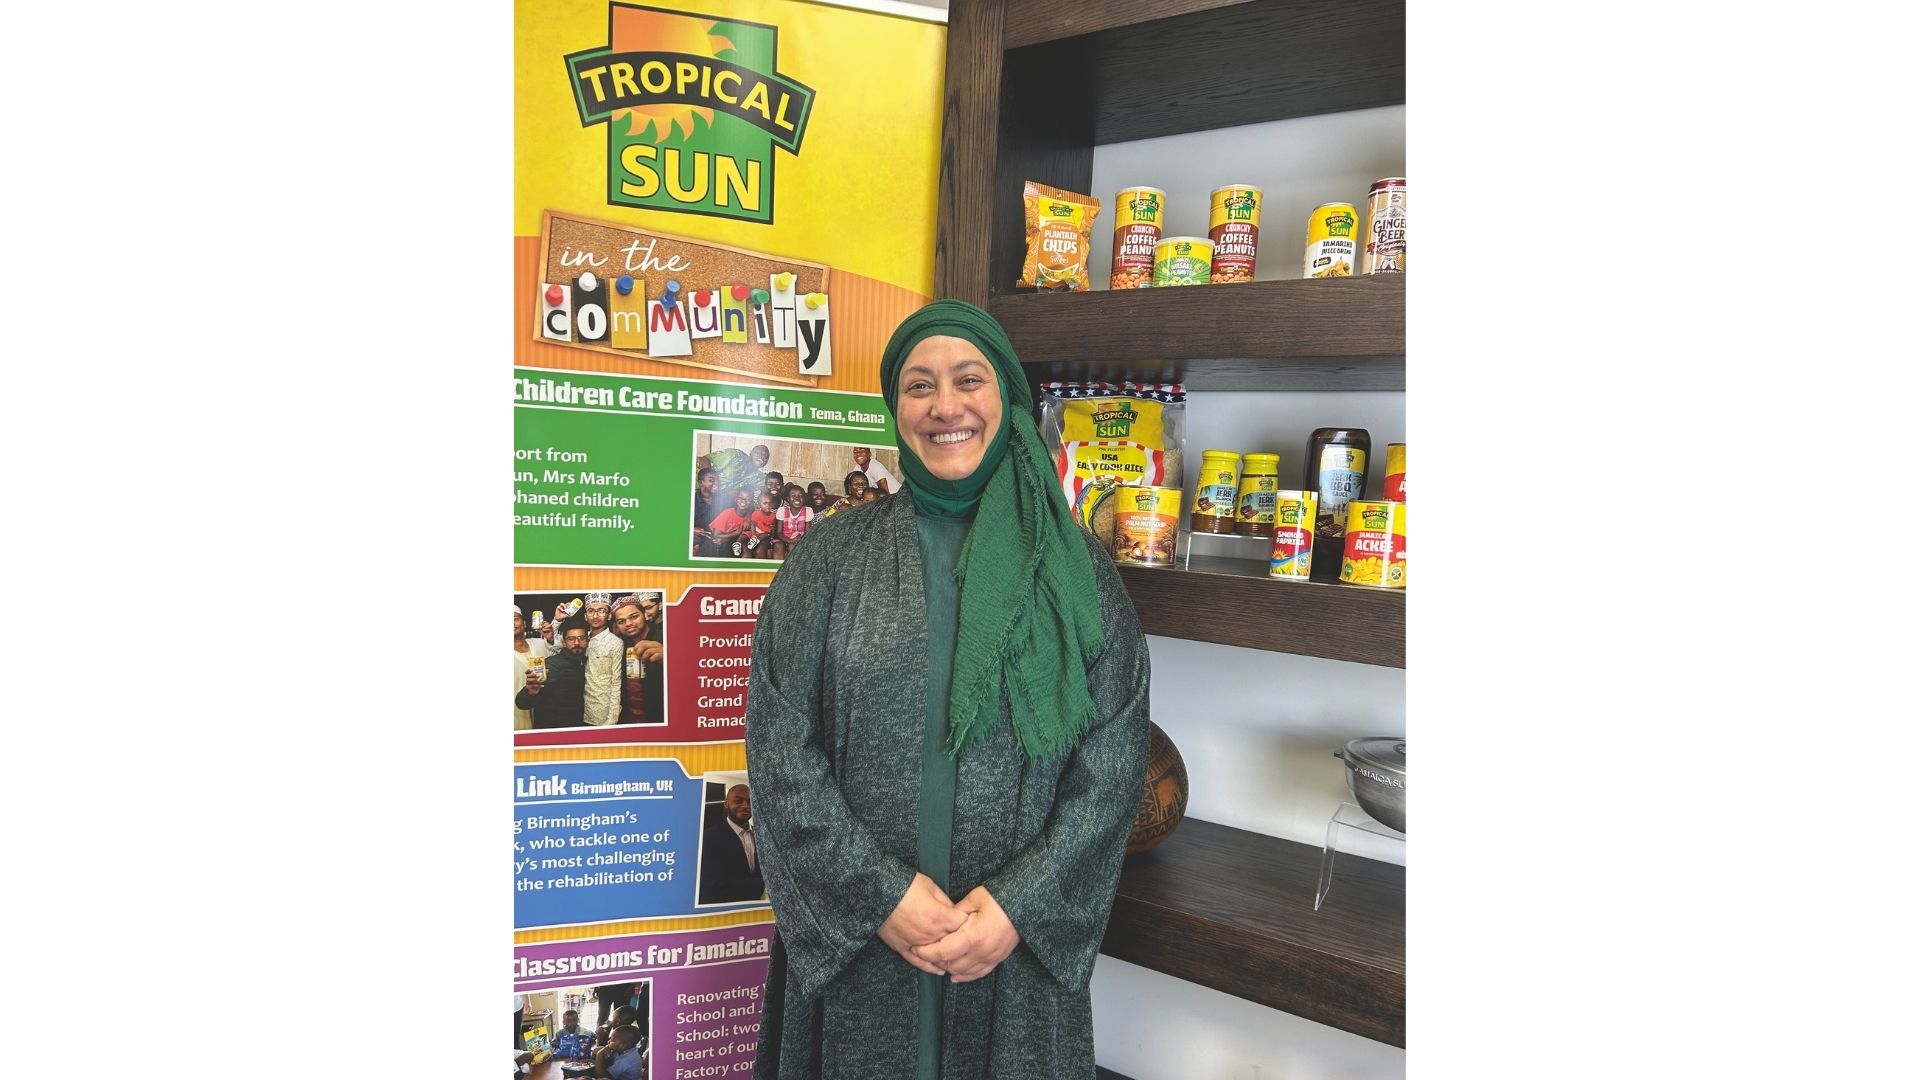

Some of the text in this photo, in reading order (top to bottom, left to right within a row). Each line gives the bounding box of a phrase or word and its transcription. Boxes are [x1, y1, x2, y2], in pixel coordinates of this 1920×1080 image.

[580, 60, 795, 131] TROPICAL
[619, 143, 762, 212] SUN
[1131, 200, 1158, 209] TROPICAL
[1226, 197, 1256, 208] TROPICAL
[1135, 211, 1154, 221] SUN
[1230, 209, 1250, 218] SUN
[1327, 216, 1353, 225] TROPICAL
[1044, 230, 1078, 240] PLANTAIN
[1131, 225, 1156, 234] CRUNCHY
[1226, 223, 1252, 233] CRUNCHY
[1330, 227, 1349, 235] SUN
[1221, 233, 1253, 245] COFFEE
[1379, 229, 1405, 243] BEER
[1043, 239, 1078, 254] CHIPS
[1120, 245, 1155, 256] PEANUT
[1214, 244, 1256, 257] PEANUTS
[560, 240, 690, 272] in the
[514, 378, 885, 424] Children Care Foundation Tema, Ghana
[1096, 411, 1134, 421] TROPICAL
[1100, 425, 1127, 437] SUN
[514, 448, 587, 462] ort from
[1101, 453, 1119, 461] USA
[1077, 461, 1098, 471] EASY
[1124, 464, 1144, 473] RICE
[514, 470, 630, 486] un, Mrs Marfo
[1330, 481, 1351, 493] BBQ
[573, 492, 639, 508] children
[514, 513, 635, 532] eautiful family.
[1366, 520, 1385, 528] SUN
[1355, 539, 1394, 552] ACKEE
[699, 634, 752, 648] Providi
[698, 657, 751, 668] coconu
[698, 675, 750, 690] Tropica
[698, 694, 742, 708] Grand
[697, 713, 747, 728] Ramad
[517, 775, 673, 798] Link Birmingham, UK
[1393, 780, 1406, 789] SU
[528, 811, 637, 830] Birmingham's
[529, 836, 565, 850] who
[569, 832, 617, 848] tackle
[621, 832, 649, 844] one
[653, 830, 670, 842] of
[542, 856, 582, 869] most
[586, 850, 675, 867] challenging
[517, 869, 674, 891] the rehabilitation of
[648, 945, 683, 965] for
[684, 936, 769, 967] Jamaica
[677, 985, 759, 1005] Renovating
[676, 1007, 725, 1024] School
[729, 1002, 755, 1018] and
[676, 1023, 760, 1042] School: two
[676, 1046, 714, 1061] heart
[718, 1042, 734, 1056] of
[676, 1064, 729, 1080] Factory
